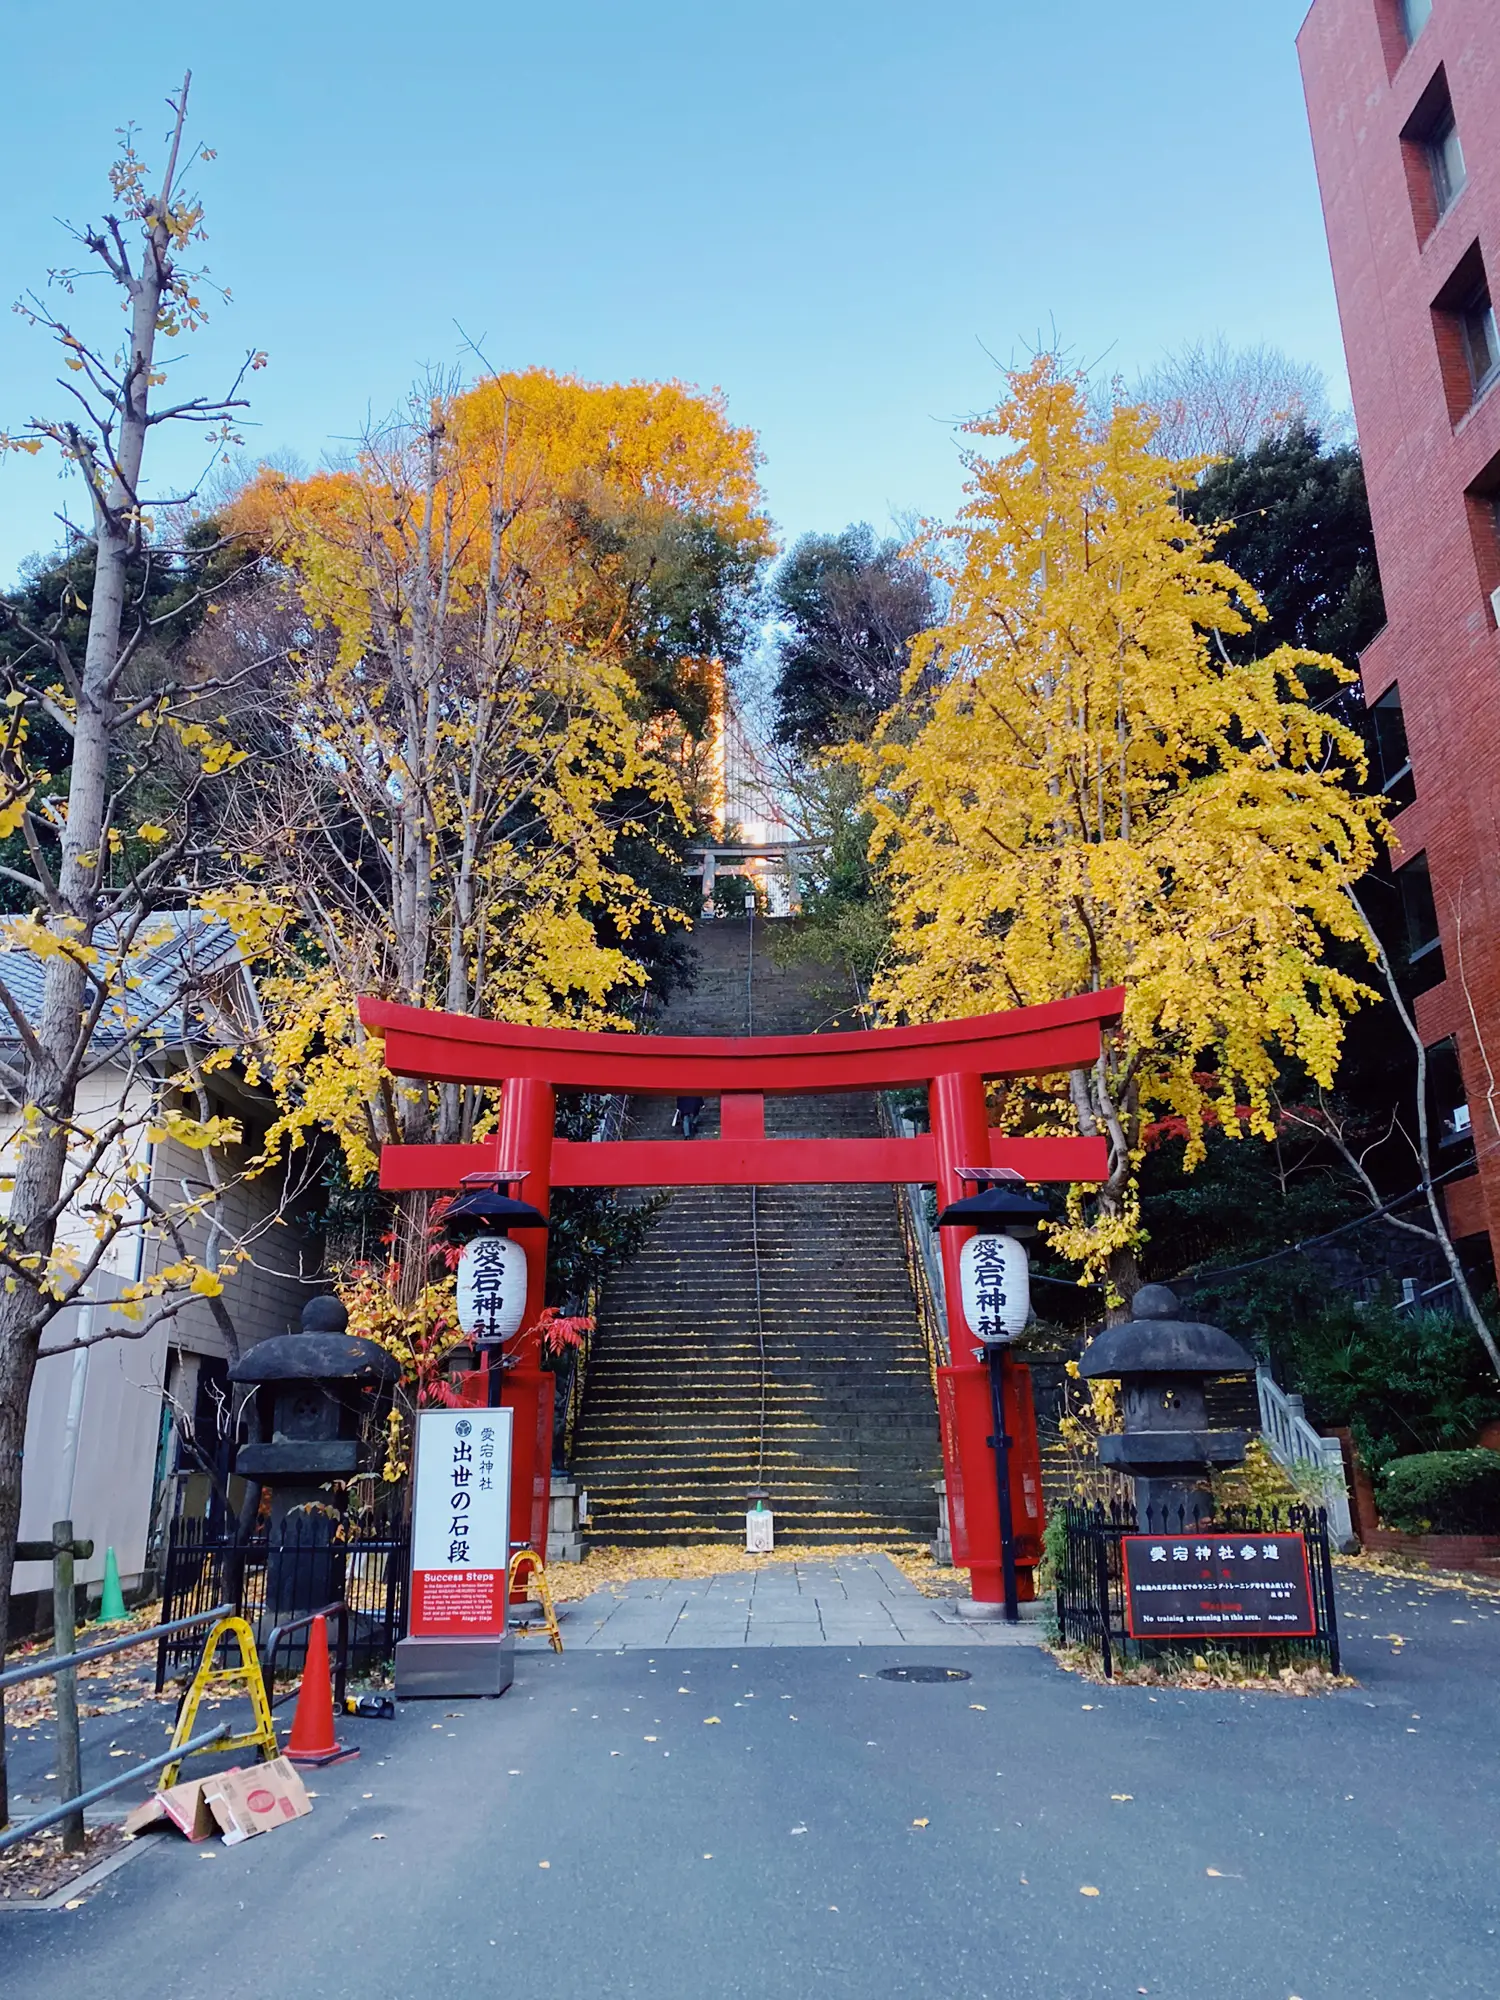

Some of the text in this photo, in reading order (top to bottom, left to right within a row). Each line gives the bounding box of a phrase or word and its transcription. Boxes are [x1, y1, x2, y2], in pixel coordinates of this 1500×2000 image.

[472, 1240, 506, 1338] 愛宕神社
[973, 1239, 1009, 1335] 愛宕神社
[479, 1427, 495, 1491] 愛宕神社
[447, 1440, 473, 1563] 出世の石段
[424, 1572, 494, 1582] Success Steps
[1150, 1545, 1279, 1561] 愛宕神社参道
[1157, 1614, 1184, 1623] training
[1196, 1614, 1221, 1622] running
[1222, 1613, 1229, 1621] in
